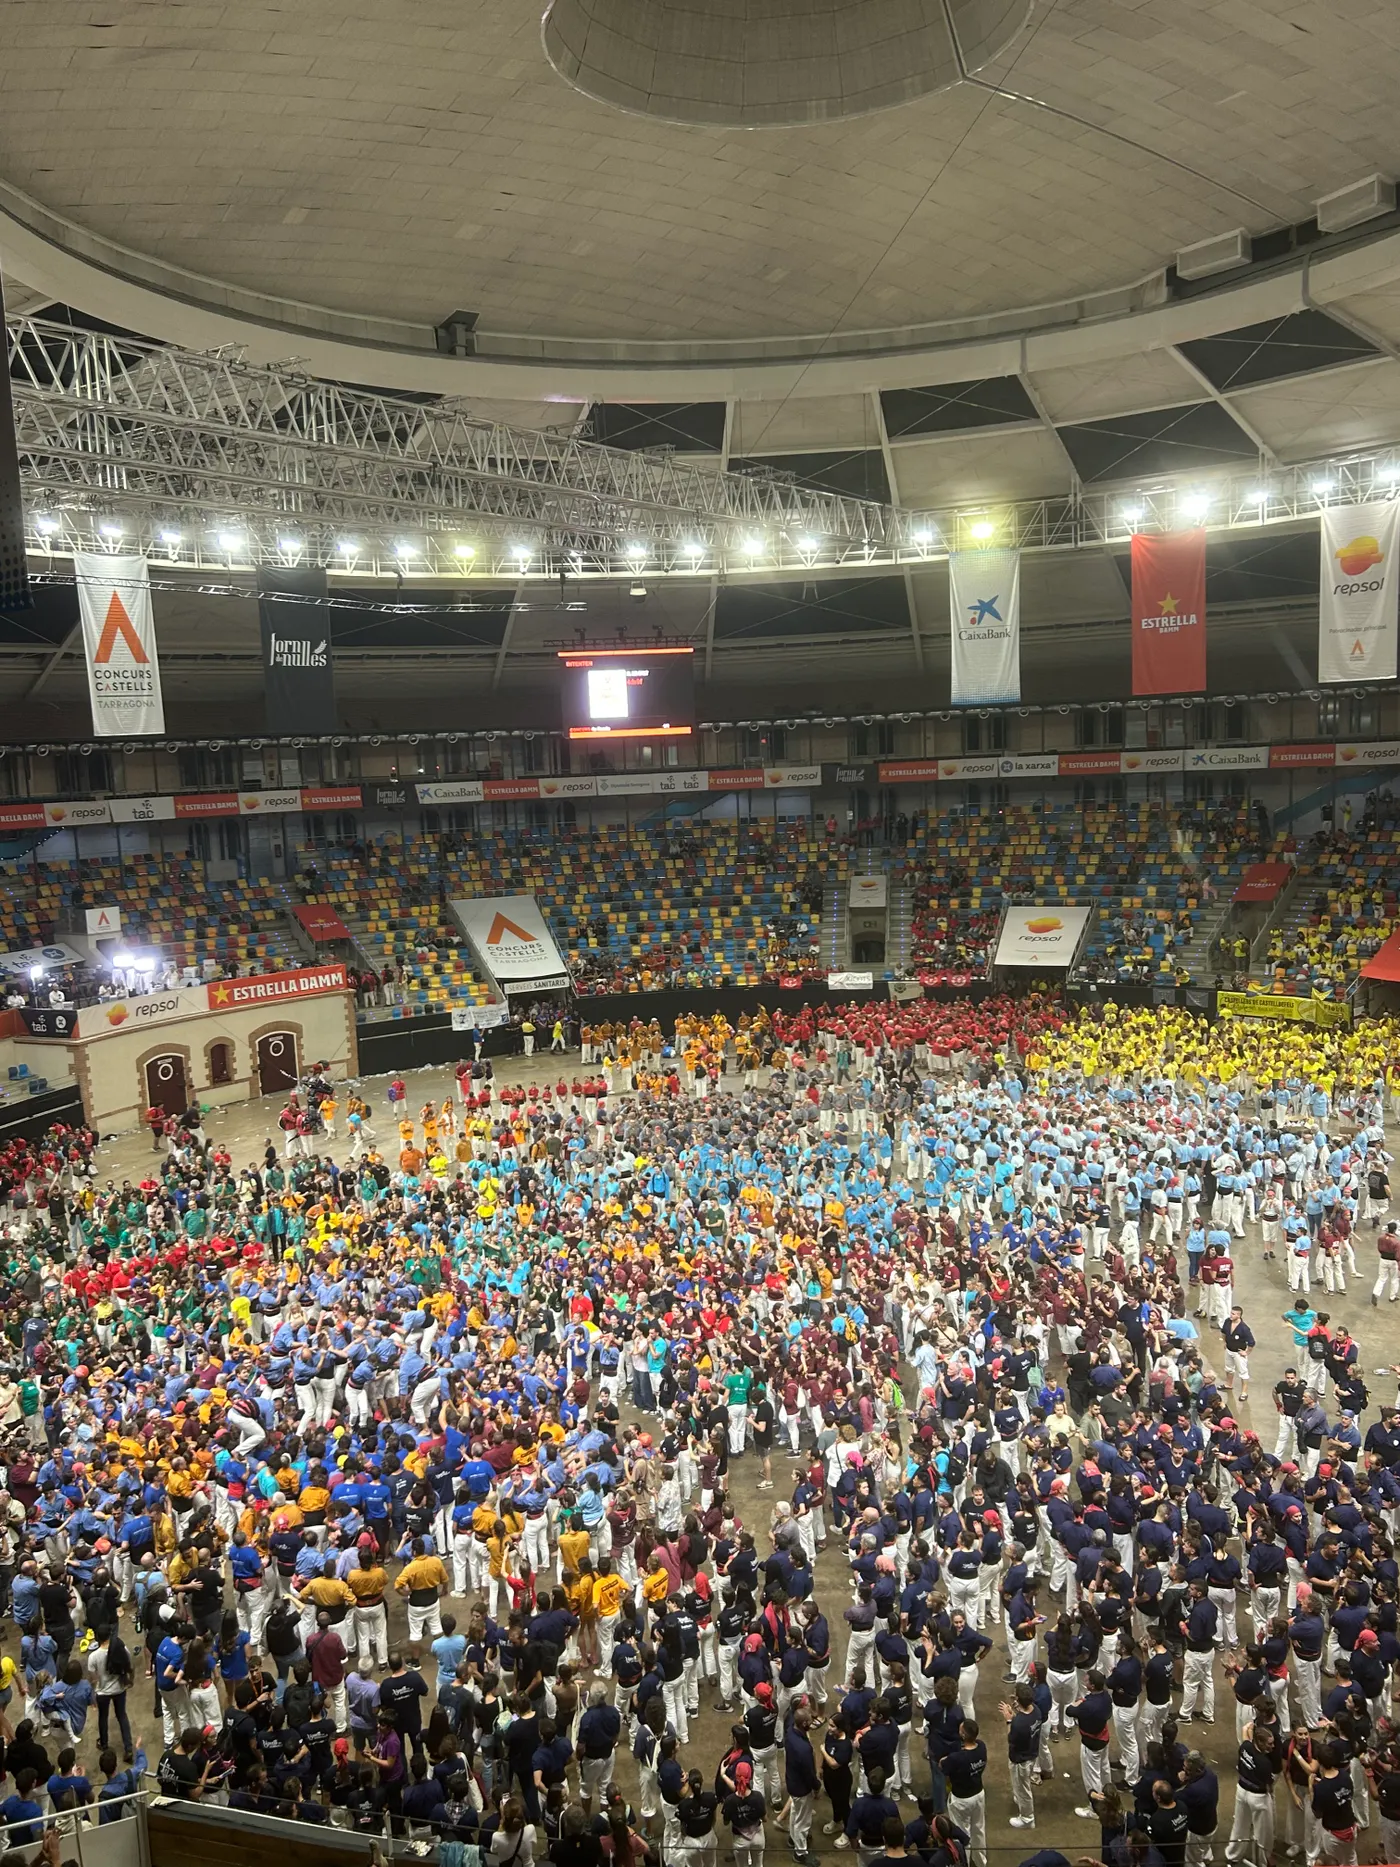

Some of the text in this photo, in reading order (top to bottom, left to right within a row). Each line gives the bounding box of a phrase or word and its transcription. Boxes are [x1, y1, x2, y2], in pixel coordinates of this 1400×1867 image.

[1333, 577, 1385, 596] repsol
[1141, 614, 1197, 629] ESTRELLA
[958, 629, 1011, 640] CaixaBank
[94, 670, 152, 679] CONCURS
[95, 682, 153, 691] CASTELLS
[97, 700, 155, 709] TARRAGONA
[1362, 748, 1399, 759] repsol
[1146, 756, 1180, 766] repsol
[1209, 754, 1261, 764] CaixaBank
[962, 764, 995, 773] repsol
[1015, 762, 1023, 770] la
[787, 772, 818, 782] repsol
[562, 782, 593, 792] repsol
[660, 782, 675, 790] tac
[683, 780, 699, 789] tac
[434, 787, 482, 798] CaixaBank
[264, 796, 298, 807] repsol
[23, 813, 44, 821] DAMM
[72, 807, 106, 818] repsol
[132, 808, 155, 819] tac
[1019, 935, 1063, 943] repsol
[487, 942, 543, 952] CONCURS
[490, 948, 545, 957] CASTELLS
[233, 972, 343, 1001] ESTRELLA DAMM
[508, 979, 566, 992] SERVEIS SANITARIS
[136, 996, 179, 1017] repsol
[31, 1021, 47, 1032] tac
